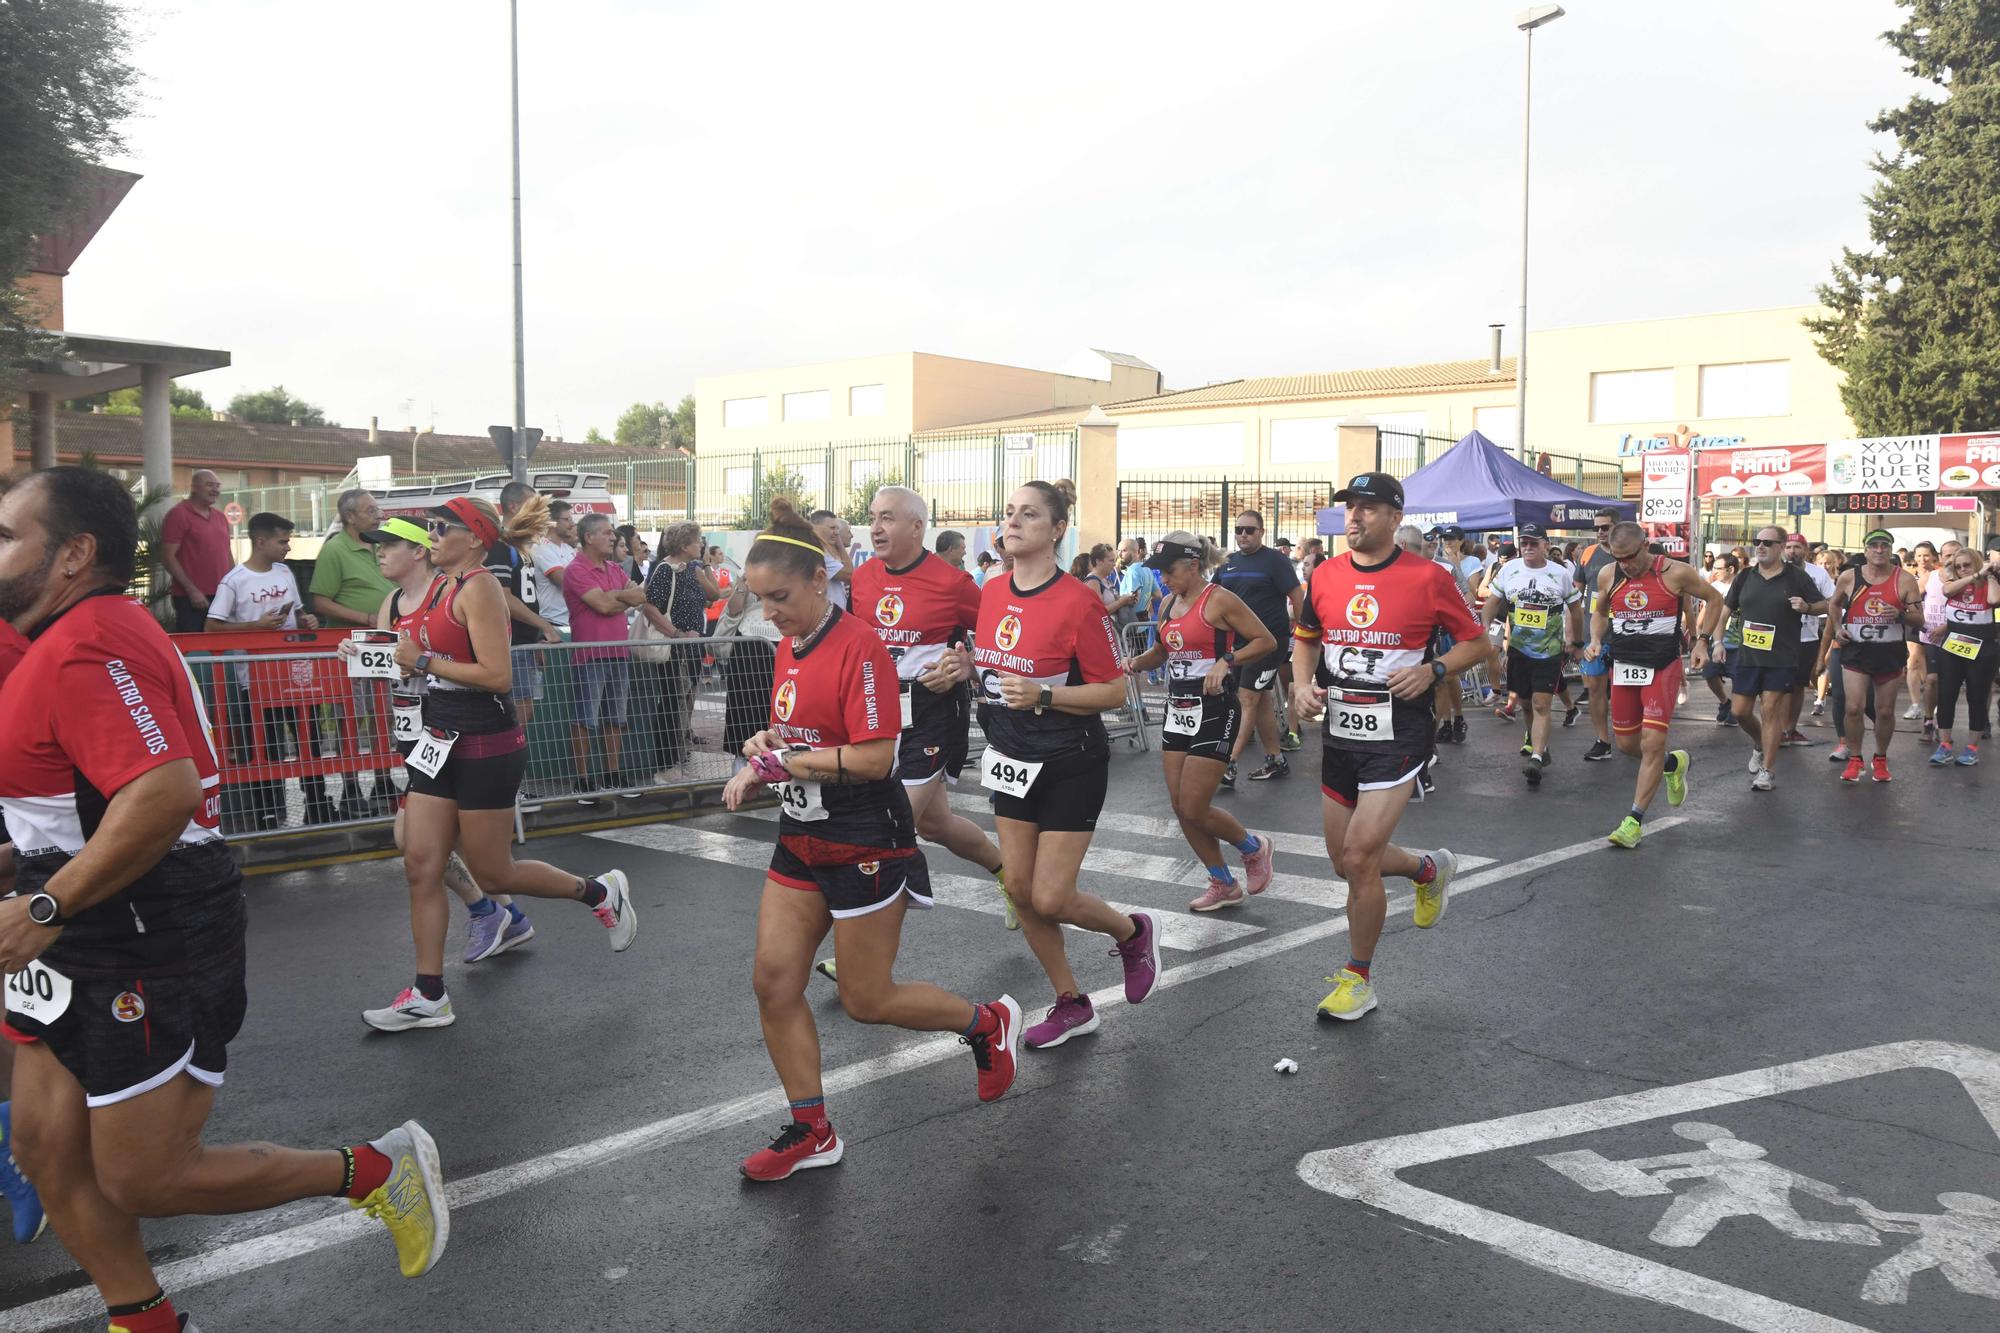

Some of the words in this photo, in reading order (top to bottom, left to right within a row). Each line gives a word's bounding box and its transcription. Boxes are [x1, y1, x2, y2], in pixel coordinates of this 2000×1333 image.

[1861, 439, 1930, 453] XXVIII
[1862, 452, 1930, 466] NON
[1965, 446, 2000, 464] FA
[1862, 464, 1930, 478] DUER
[1861, 476, 1930, 490] MAS
[1520, 612, 1541, 624] 793
[887, 628, 922, 644] SANTOS
[1361, 631, 1402, 646] SANTOS
[1859, 624, 1889, 640] CT
[1951, 643, 1972, 655] 728
[361, 651, 393, 669] 629
[1001, 653, 1034, 674] SANTOS
[861, 661, 878, 695] CUATRO
[1623, 668, 1648, 680] 183
[105, 659, 144, 707] CUATRO
[129, 704, 169, 756] SANTOS
[866, 695, 879, 731] SANTOS
[1173, 713, 1196, 729] 346
[1223, 708, 1236, 740] WONG
[1339, 711, 1378, 731] 298
[990, 762, 1028, 787] 494
[22, 1000, 36, 1011] GEA
